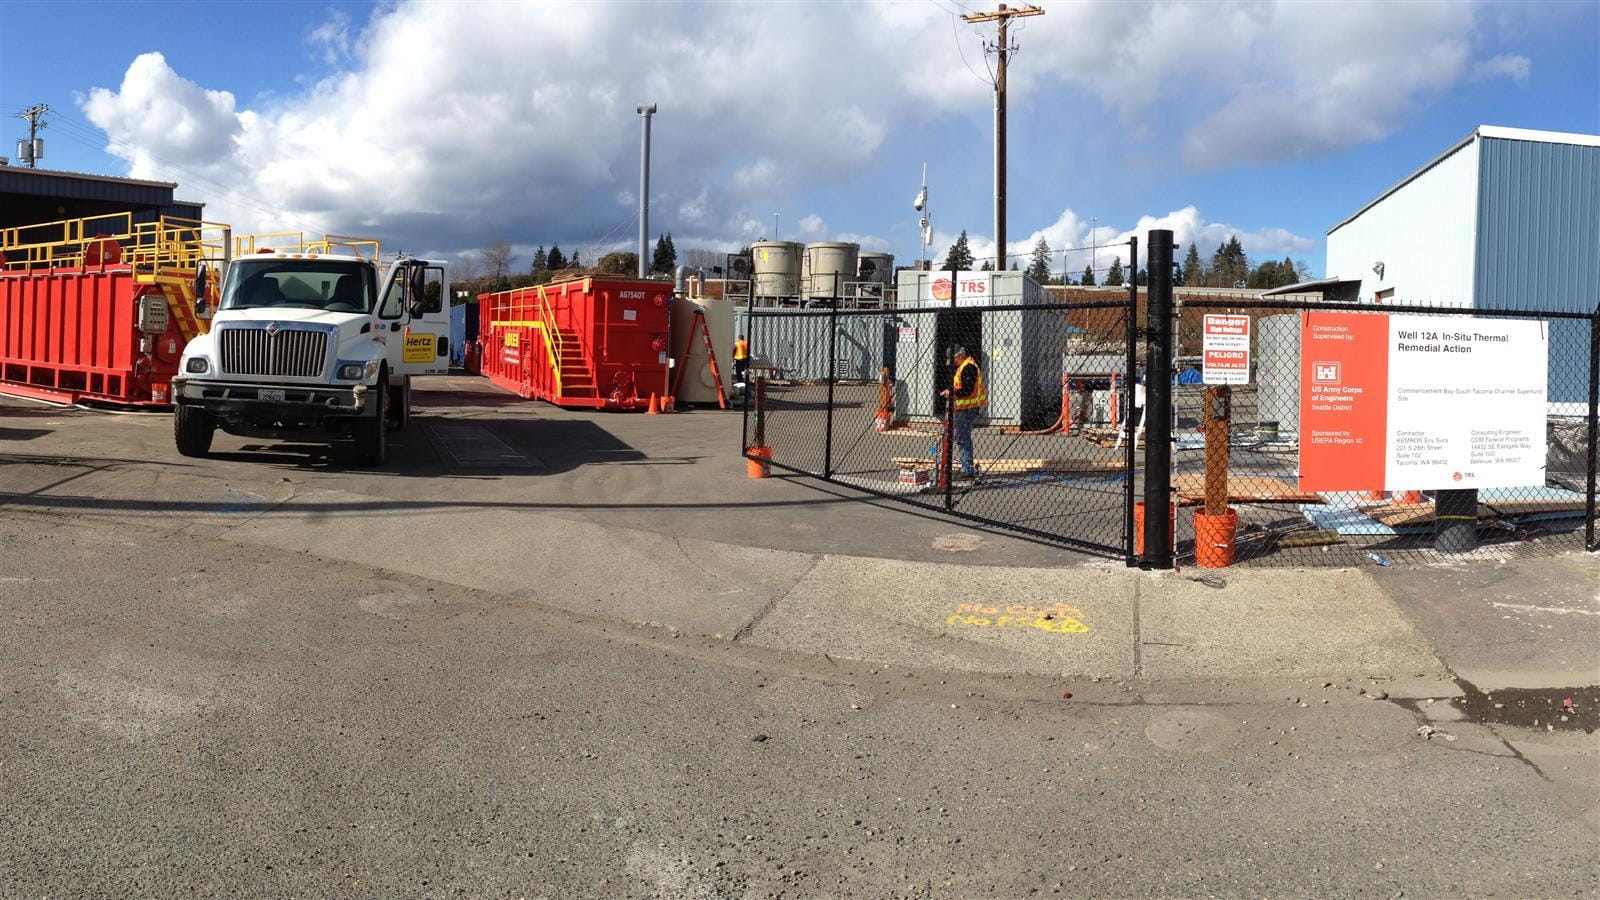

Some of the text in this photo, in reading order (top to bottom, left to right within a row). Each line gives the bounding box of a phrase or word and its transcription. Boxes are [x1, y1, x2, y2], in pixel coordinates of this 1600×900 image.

[960, 281, 985, 293] TRS
[1207, 317, 1247, 326] Danger
[1398, 331, 1509, 342] Well 12A In-Situ Thermal
[406, 338, 432, 346] Hertz
[1398, 343, 1472, 353] Remedial Action
